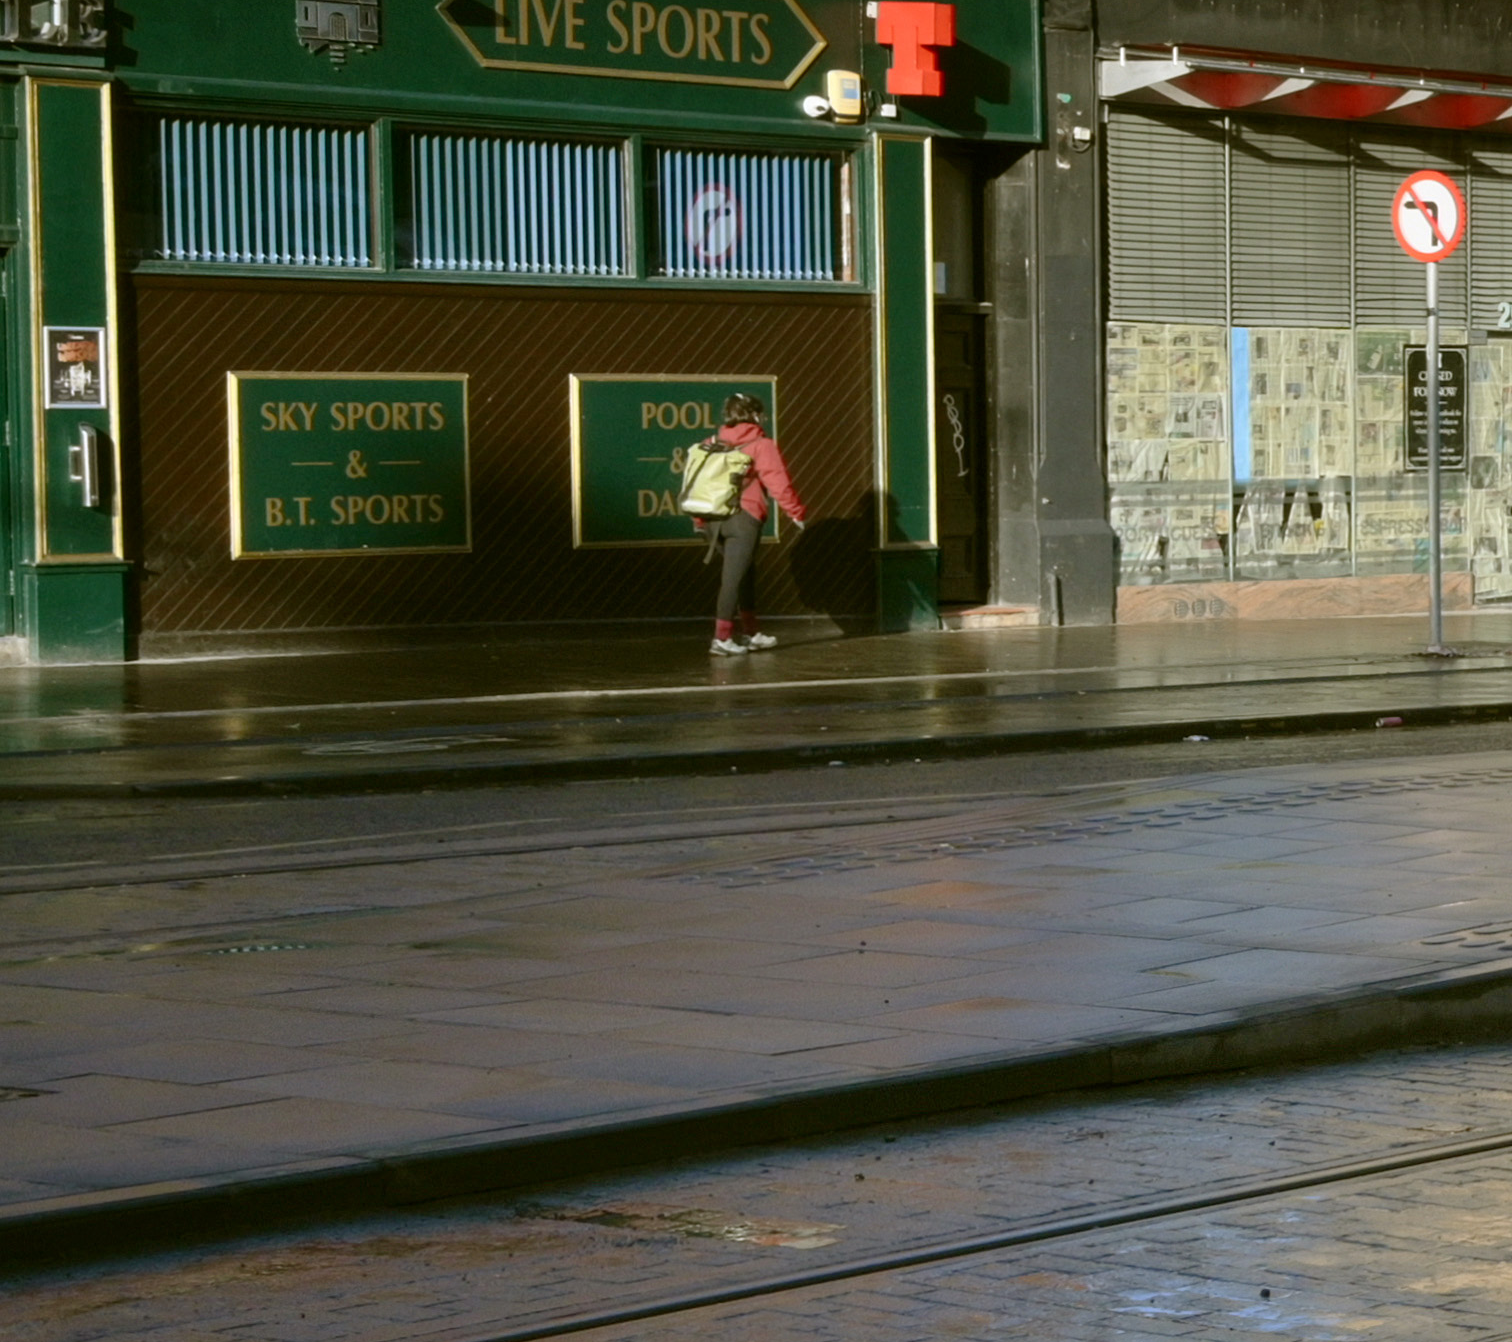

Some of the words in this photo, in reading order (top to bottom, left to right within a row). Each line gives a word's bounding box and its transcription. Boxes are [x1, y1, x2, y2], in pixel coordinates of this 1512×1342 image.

[606, 0, 772, 65] SPORTS
[261, 402, 317, 431] SKY
[330, 401, 445, 431] SPORTS
[641, 402, 716, 429] POOL
[345, 450, 367, 478] &
[265, 497, 316, 526] B.T.
[330, 495, 445, 525] SPORTS
